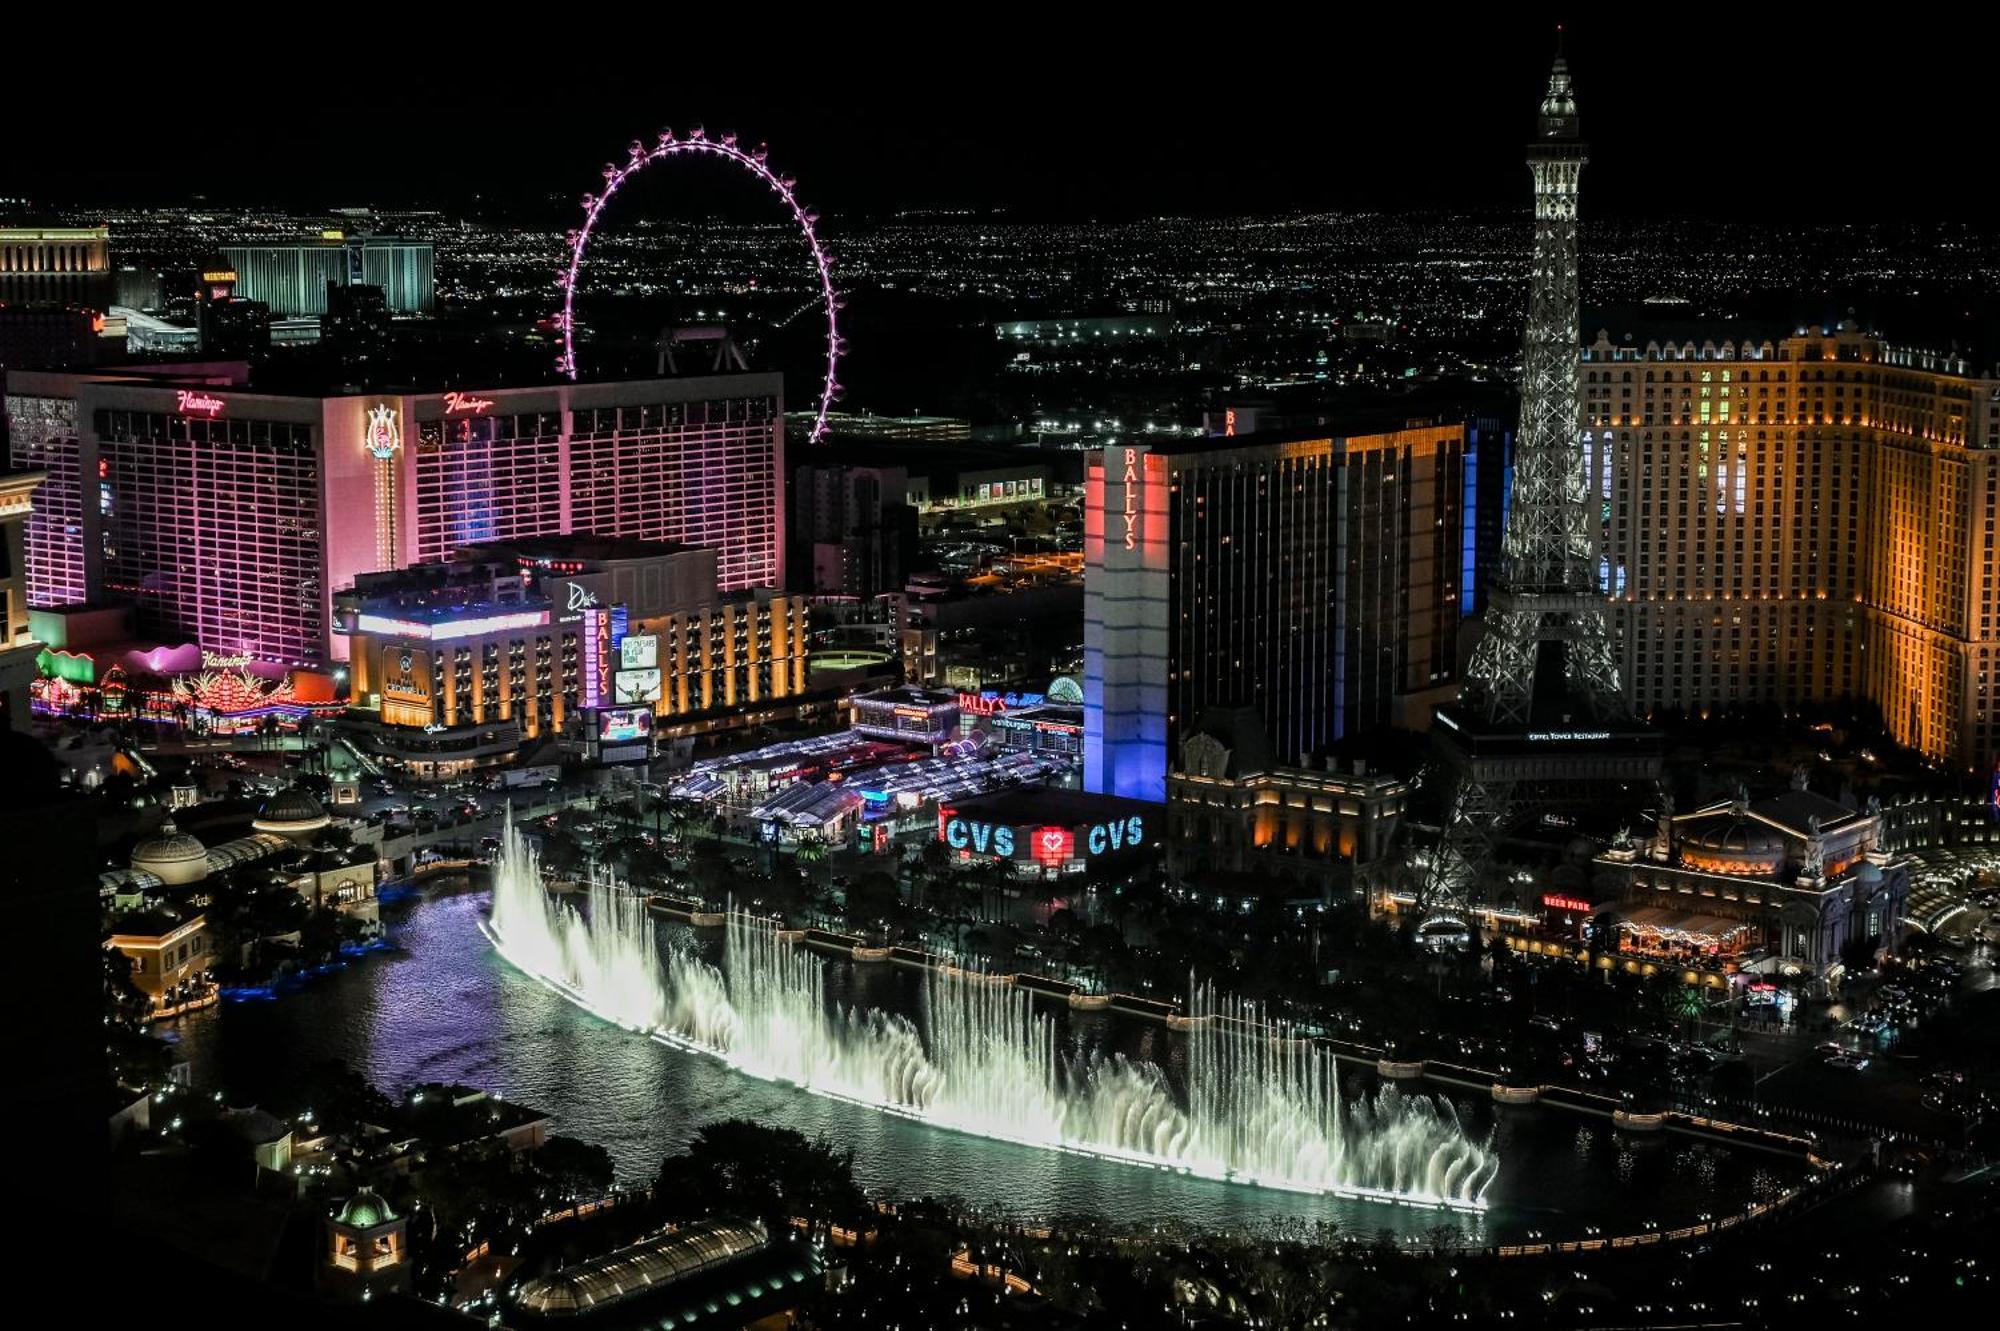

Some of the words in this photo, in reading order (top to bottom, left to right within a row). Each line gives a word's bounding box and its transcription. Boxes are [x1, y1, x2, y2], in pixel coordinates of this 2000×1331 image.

[177, 390, 225, 417] Flamingo
[443, 391, 494, 414] Flamingo
[202, 650, 254, 672] Flamingo
[597, 613, 608, 695] BALLYS
[959, 693, 1006, 713] BALLY'S
[947, 819, 1015, 857] CVS
[1088, 816, 1143, 855] CVS
[1544, 897, 1566, 908] BEER
[1567, 900, 1590, 911] PARK
